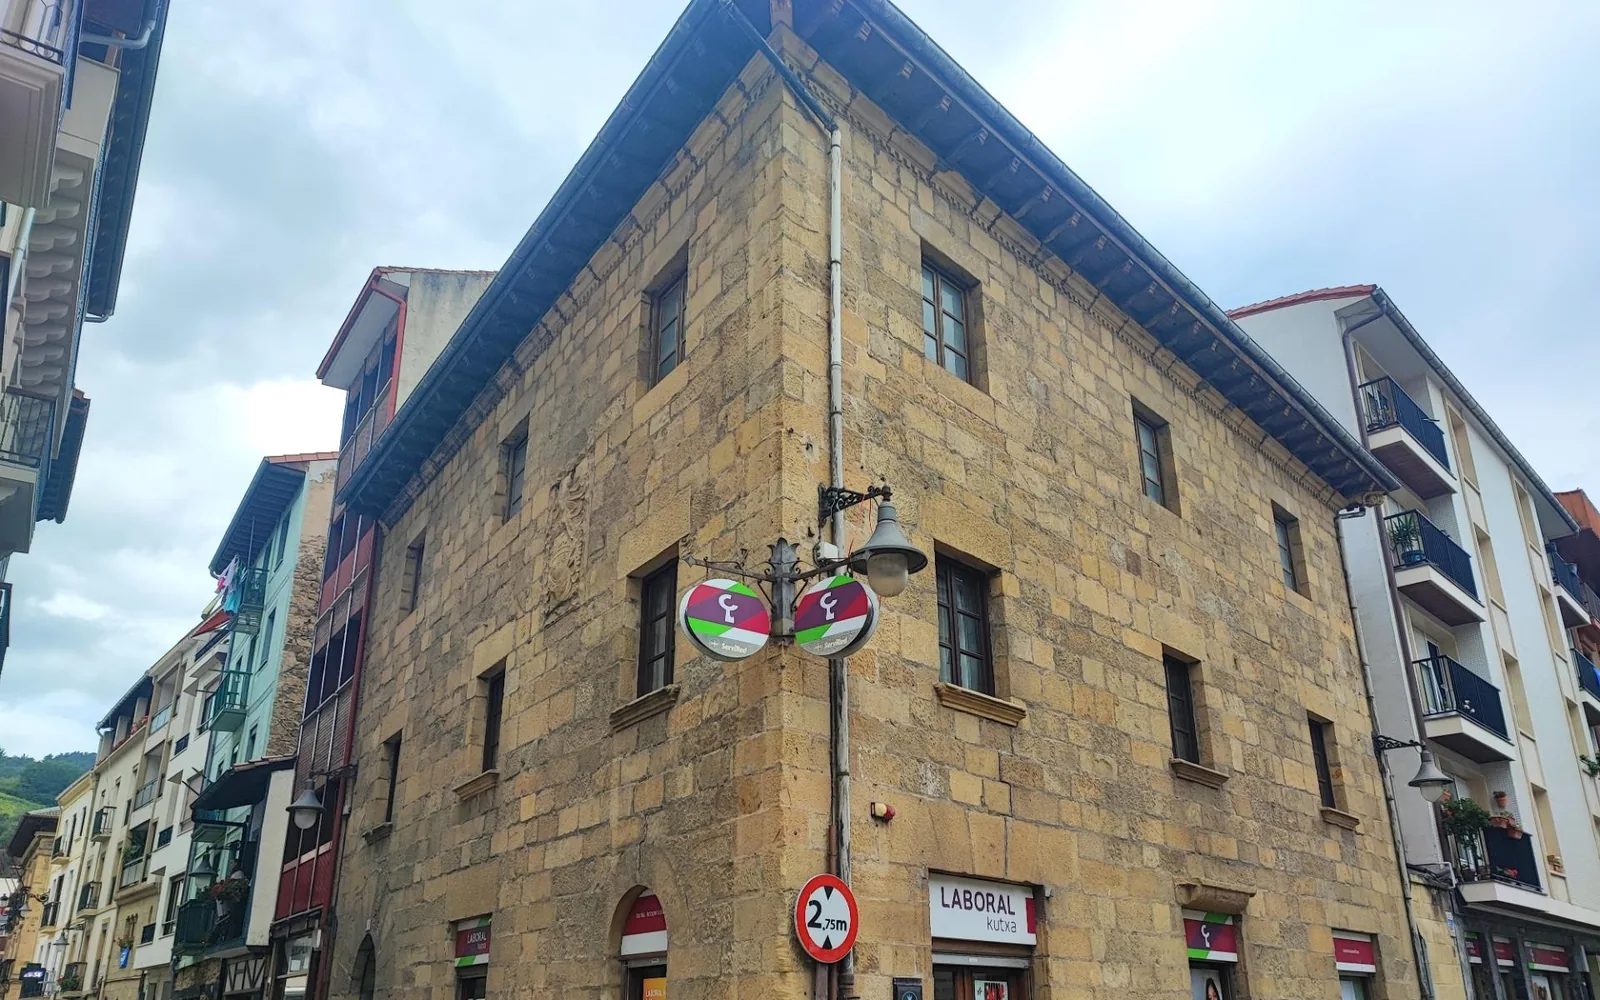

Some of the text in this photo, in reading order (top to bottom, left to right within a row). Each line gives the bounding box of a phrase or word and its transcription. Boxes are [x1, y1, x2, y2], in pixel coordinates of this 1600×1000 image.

[940, 886, 1016, 915] LABORAL
[986, 916, 1017, 933] kutxa
[467, 932, 487, 944] LABORAL
